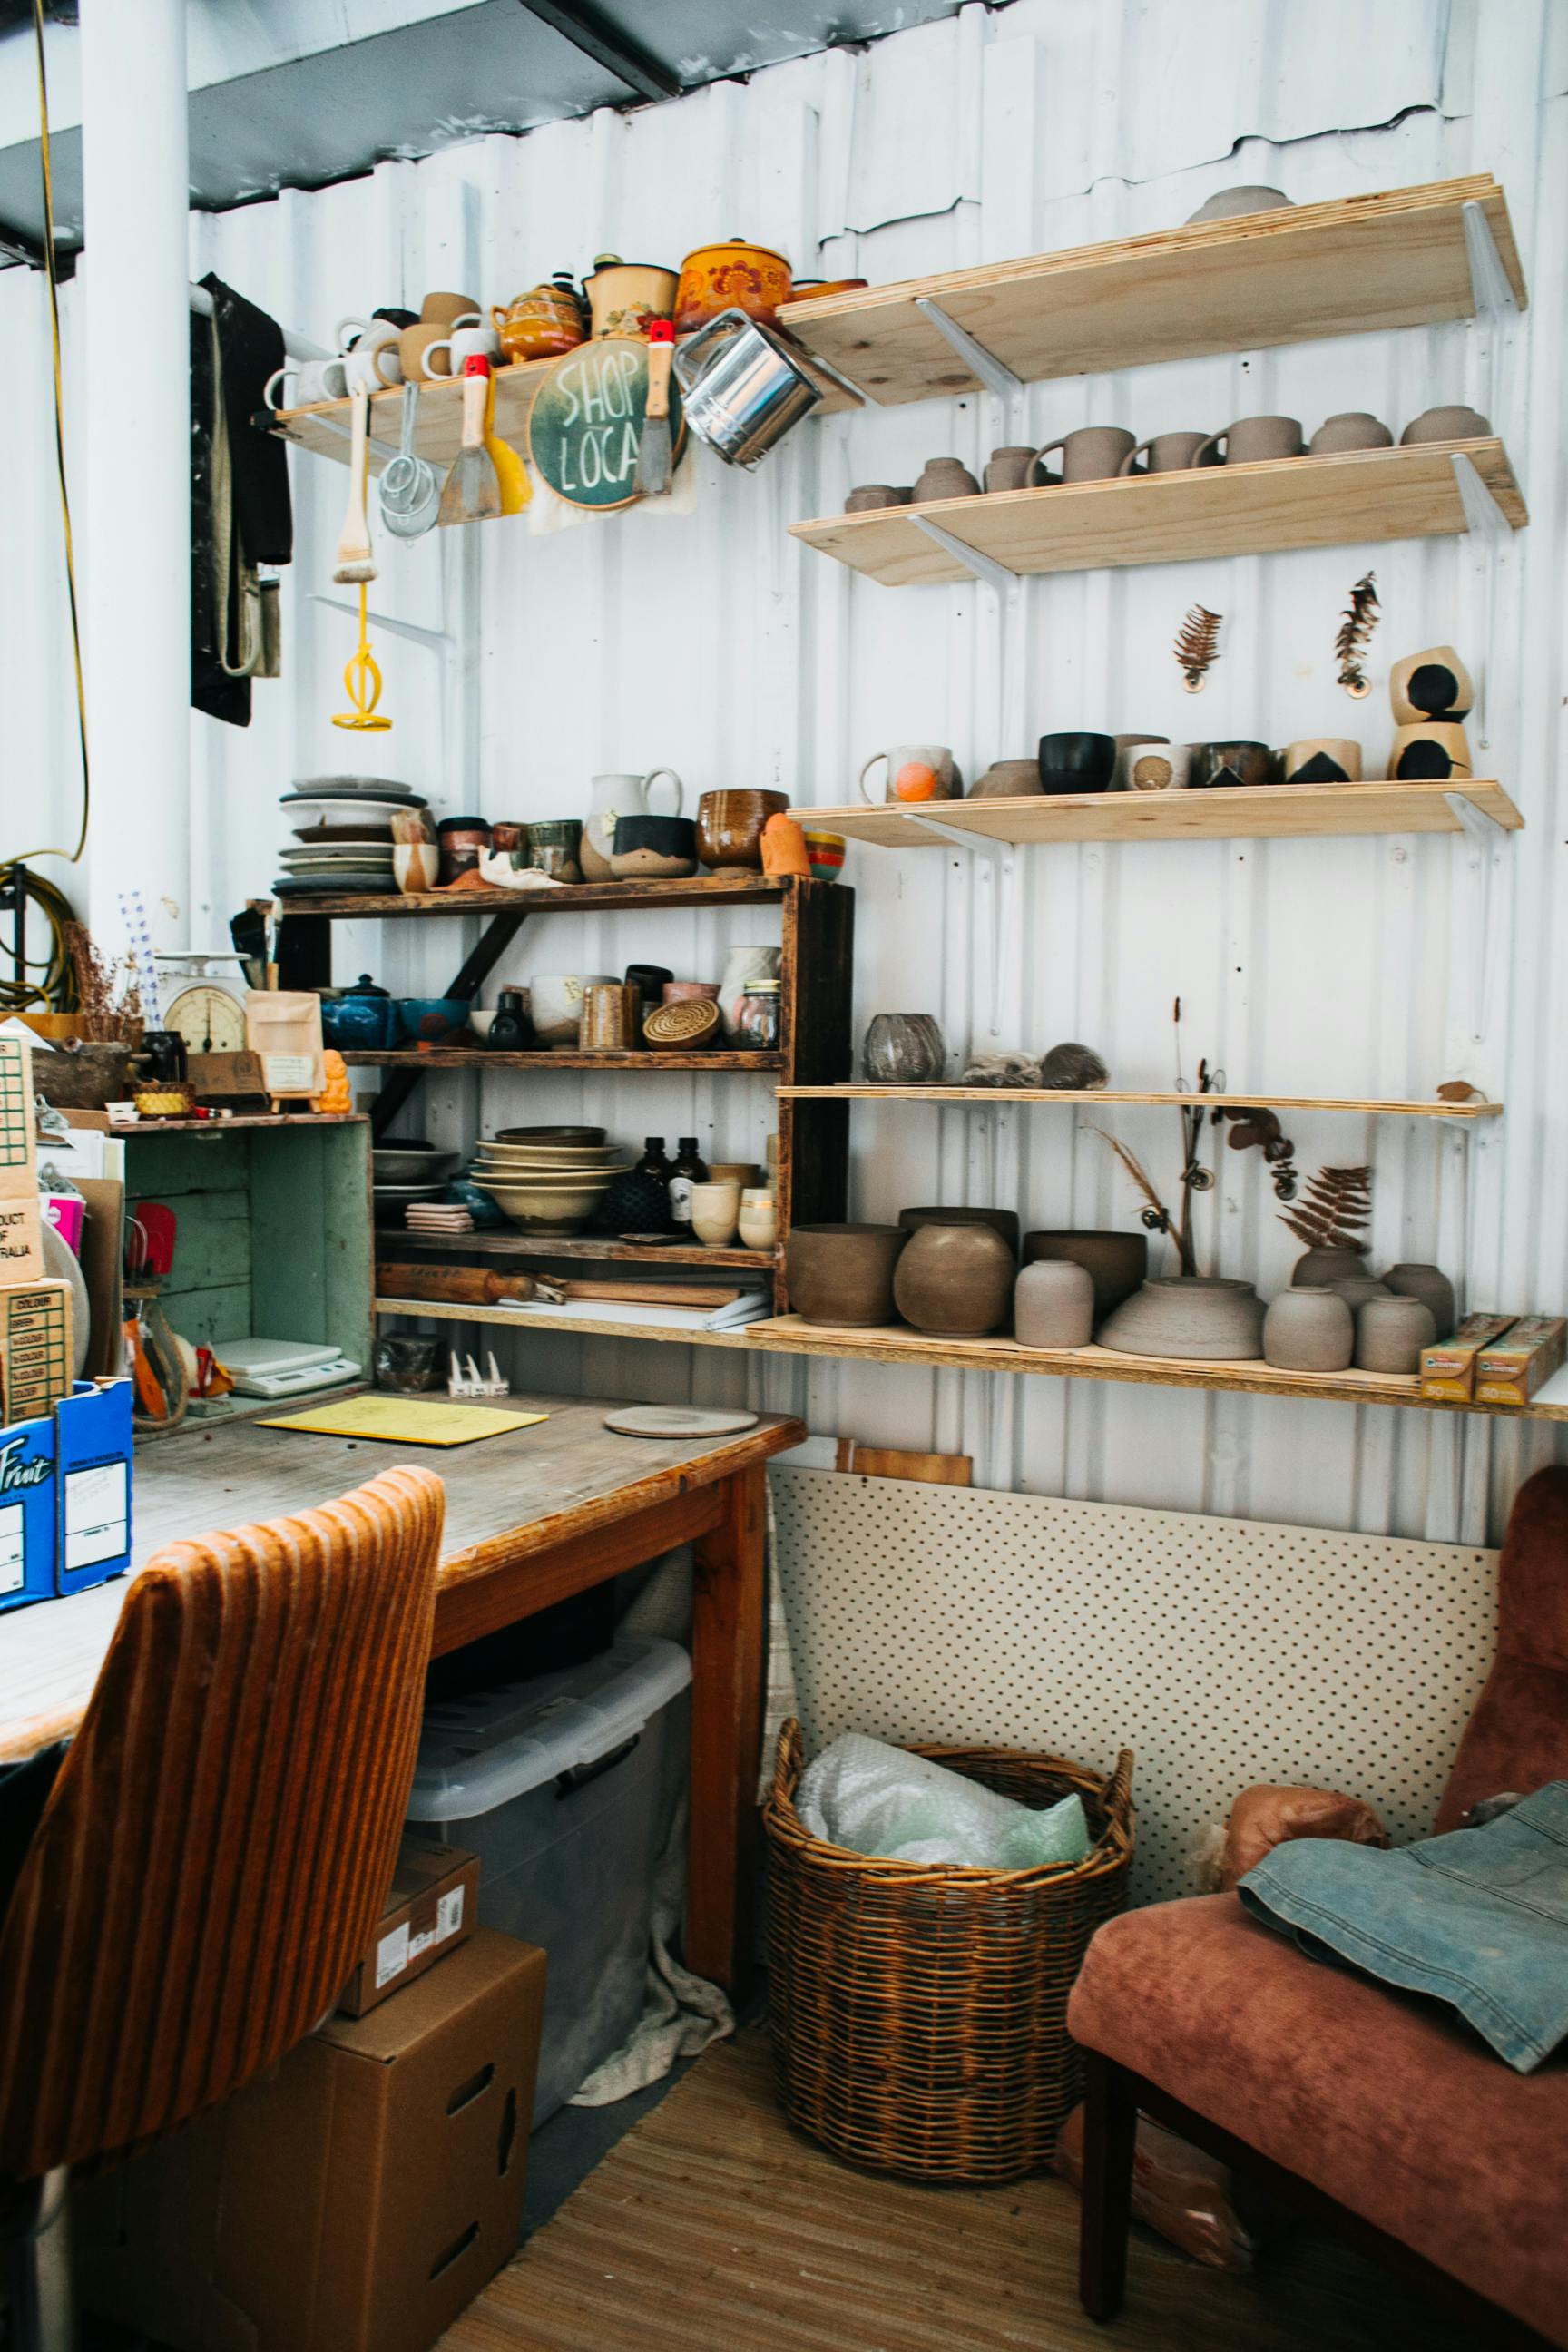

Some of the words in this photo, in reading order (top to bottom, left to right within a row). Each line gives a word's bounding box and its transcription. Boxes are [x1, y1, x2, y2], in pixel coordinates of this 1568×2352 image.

[556, 350, 639, 426] SHOP
[561, 423, 639, 491] LOCA
[16, 1298, 51, 1309] COLOUR
[0, 1437, 51, 1492] Fruit
